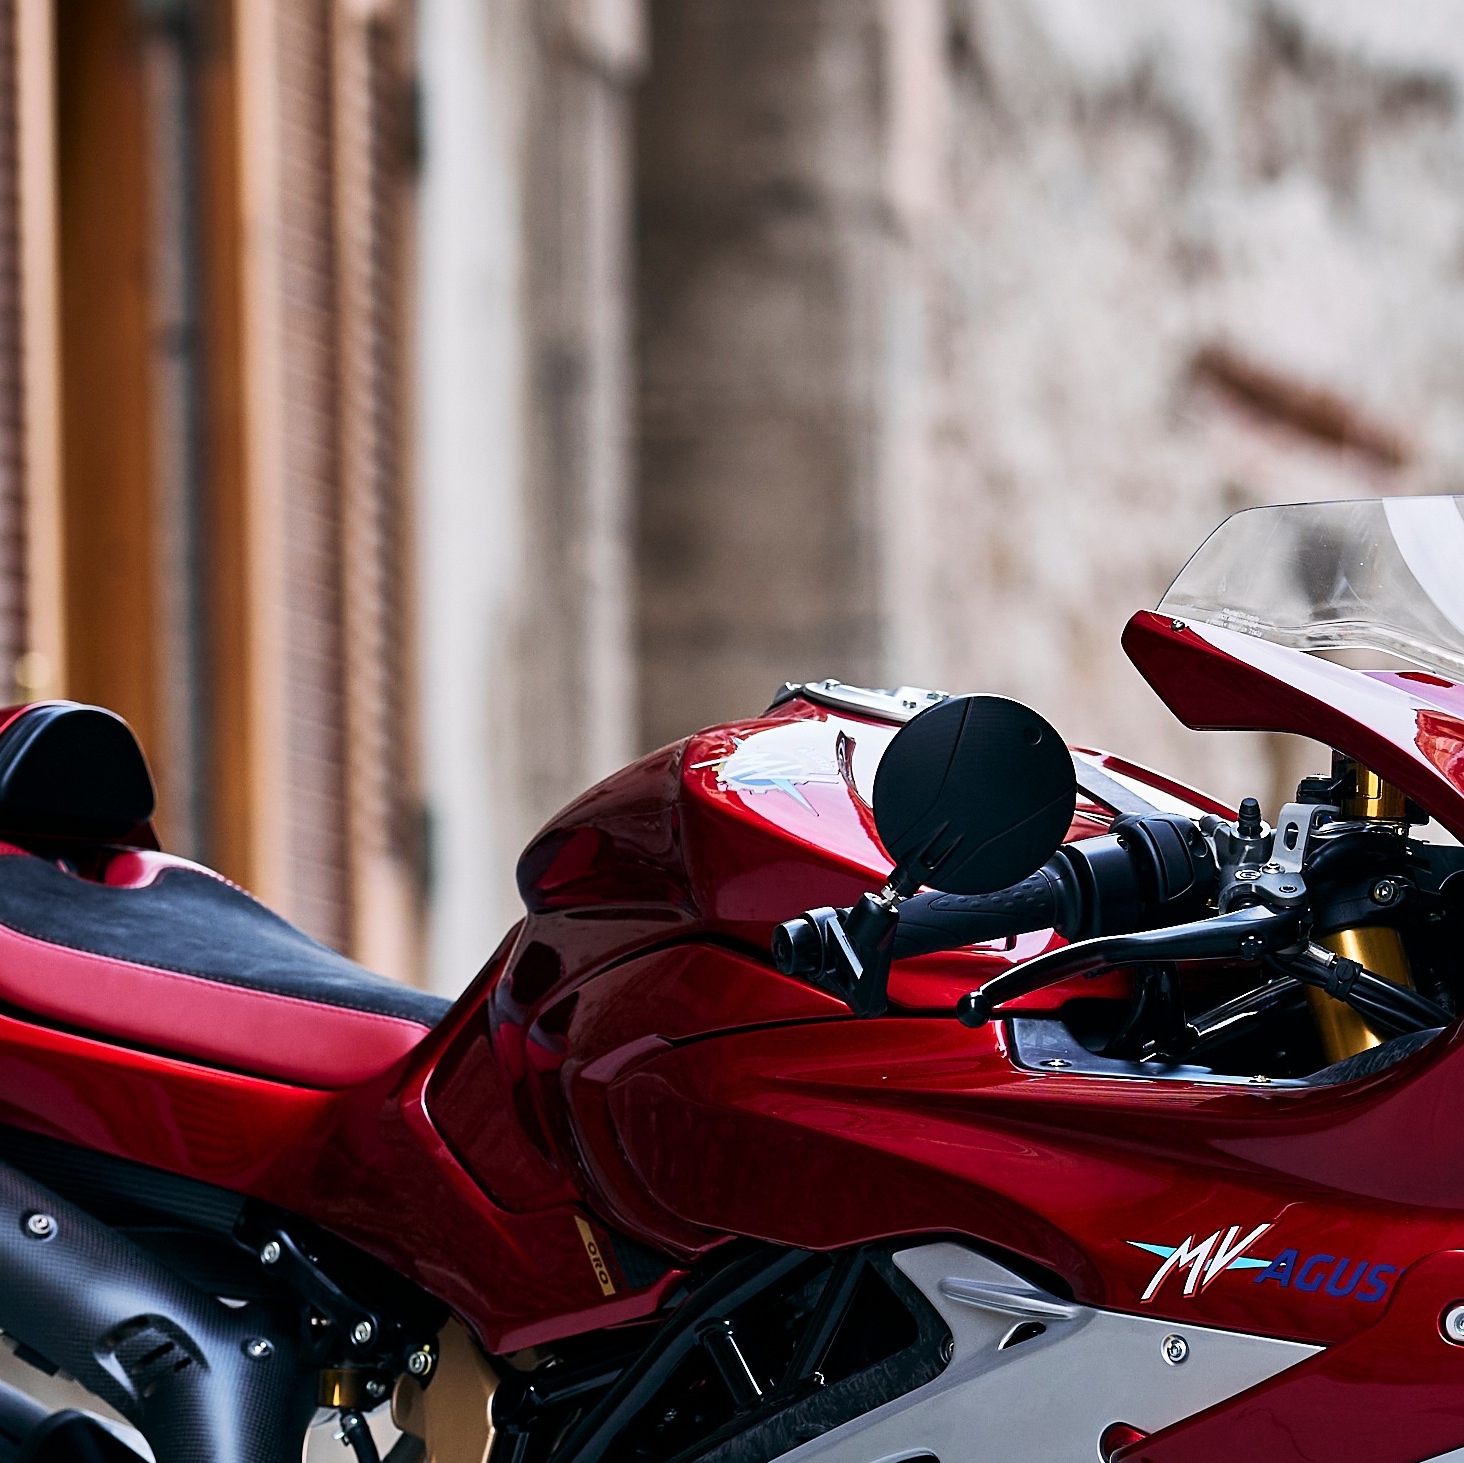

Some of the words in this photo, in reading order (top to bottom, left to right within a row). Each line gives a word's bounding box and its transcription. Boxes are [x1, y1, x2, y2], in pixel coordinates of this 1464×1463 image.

[587, 1241, 609, 1285] ORO
[1139, 1222, 1277, 1304] MV
[1253, 1247, 1405, 1303] AGUS
